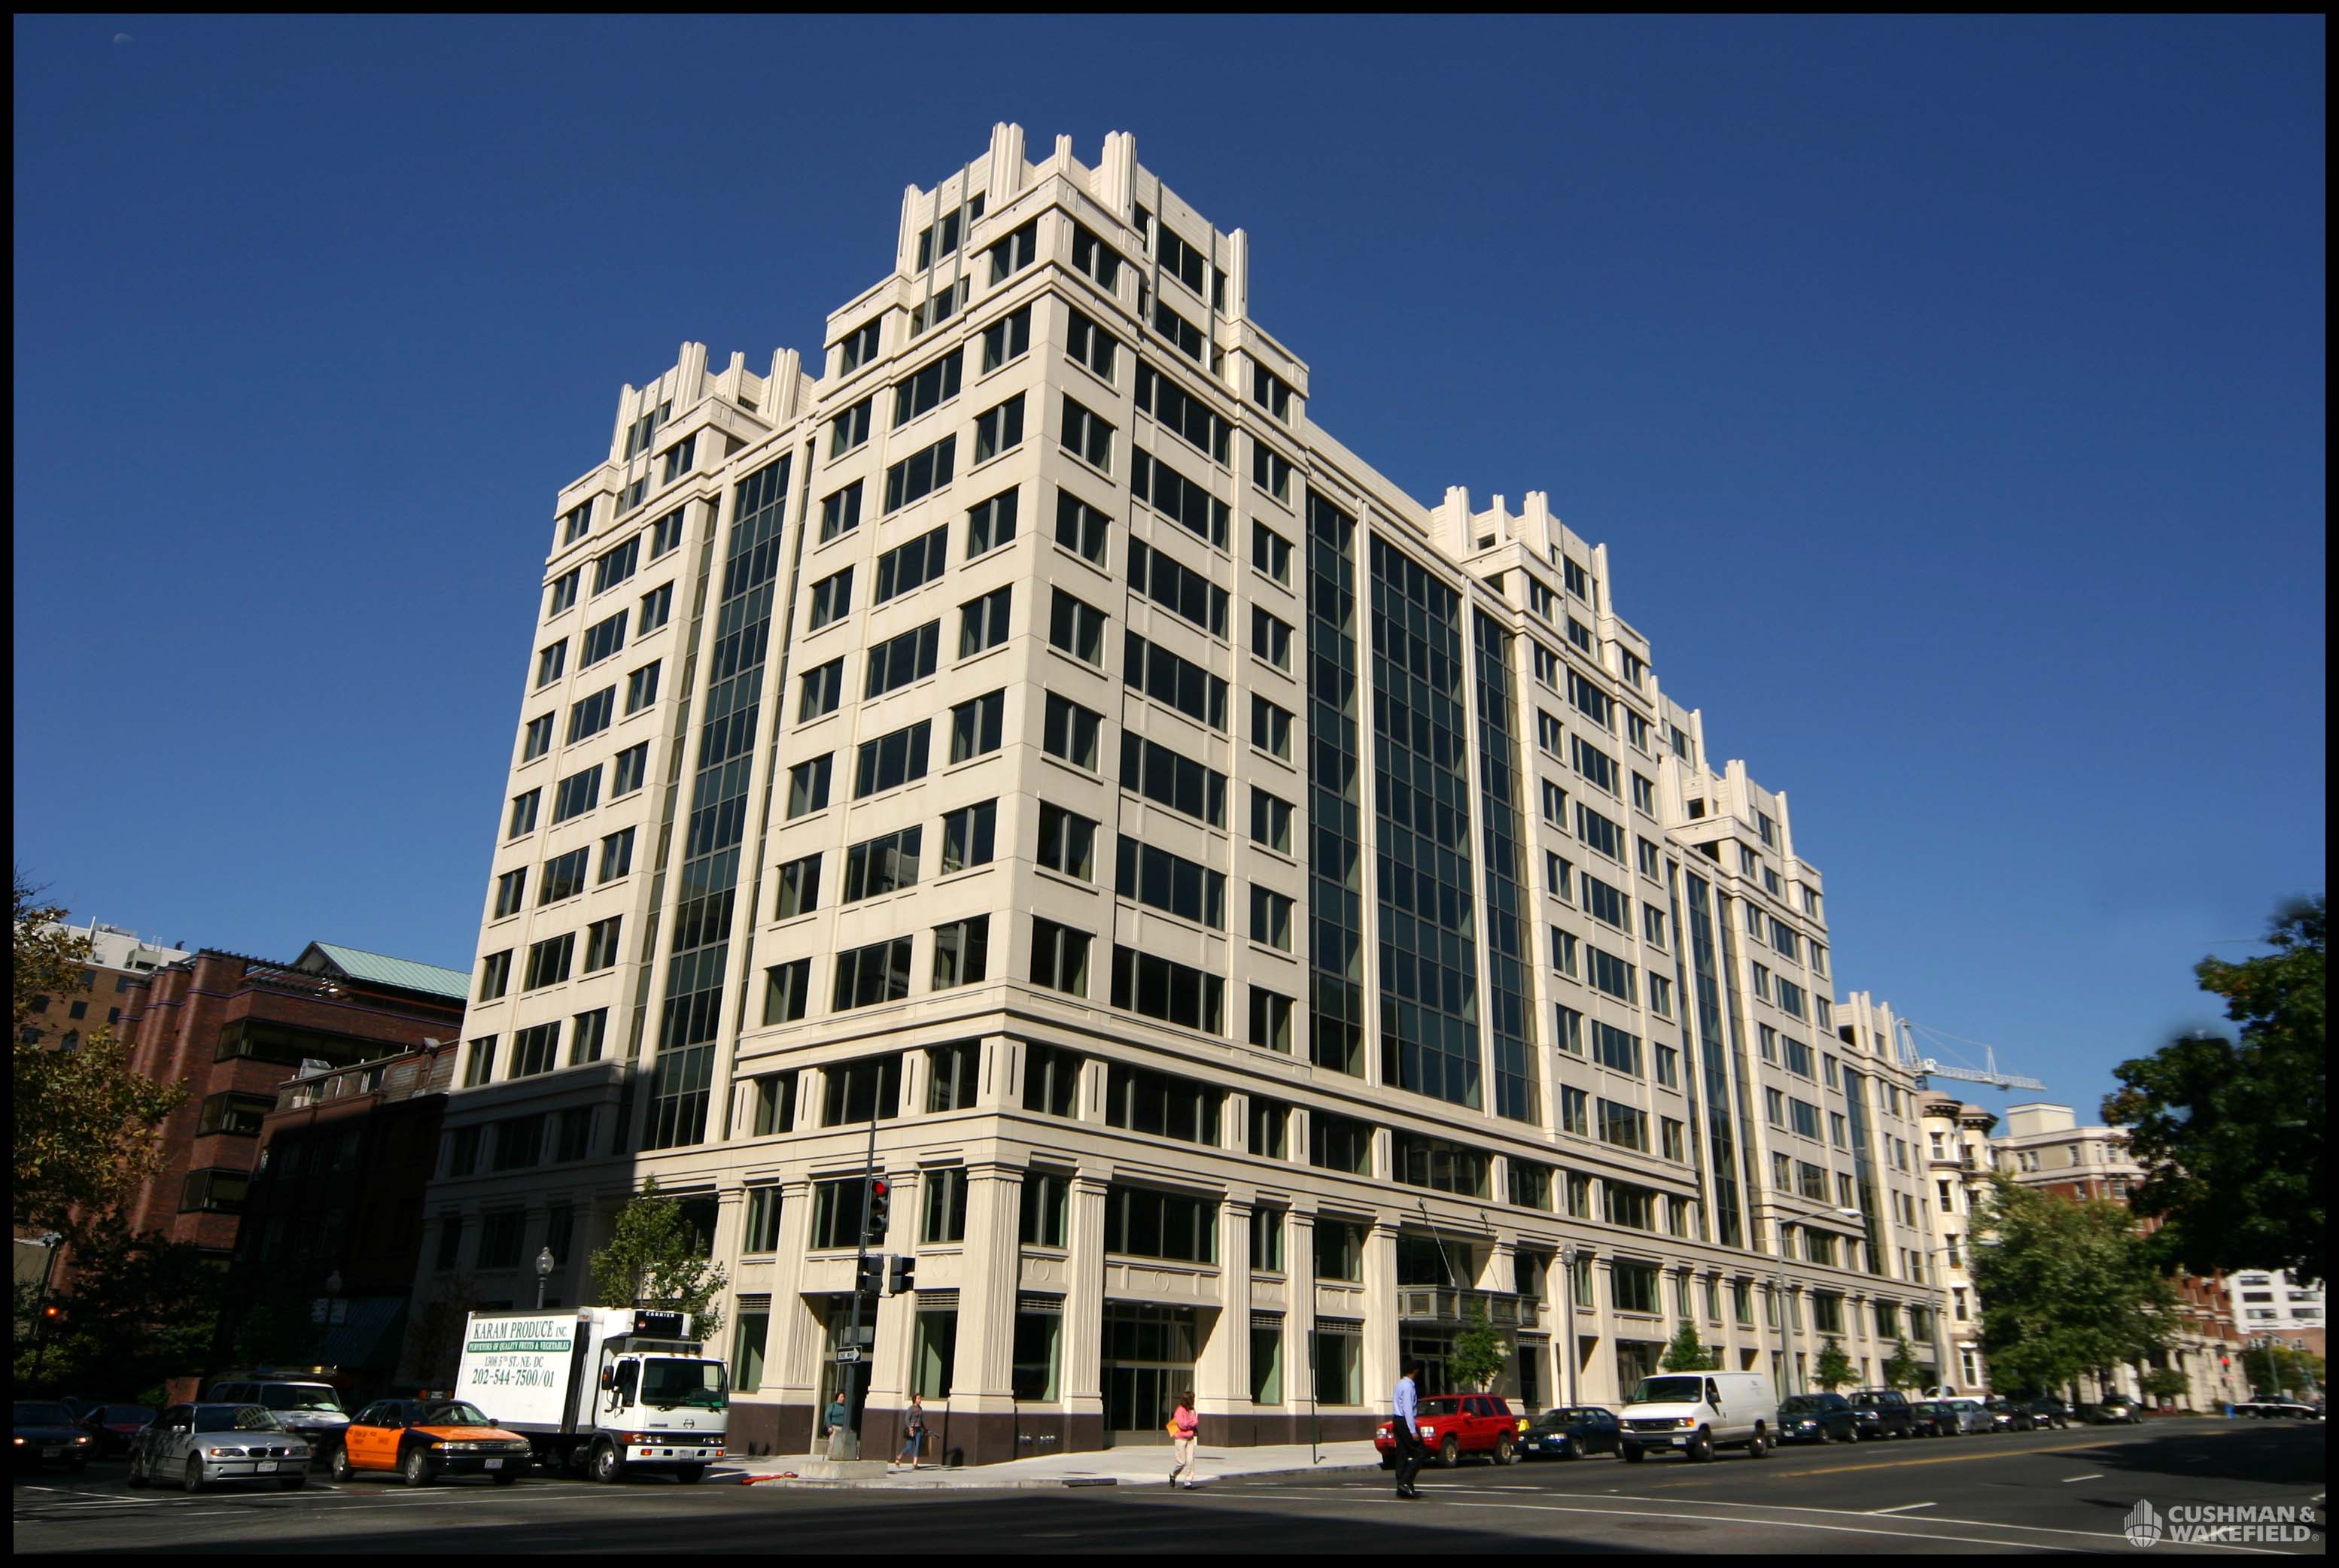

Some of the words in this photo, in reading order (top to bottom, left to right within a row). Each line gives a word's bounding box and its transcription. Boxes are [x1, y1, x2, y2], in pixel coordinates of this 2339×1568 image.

[474, 1323, 508, 1339] KARAM
[510, 1320, 554, 1338] PRODUCE
[498, 1342, 518, 1351] QUALITY
[518, 1342, 535, 1351] FRUITS
[540, 1341, 570, 1350] VEGETABLES
[533, 1356, 544, 1368] DC
[472, 1369, 554, 1387] 202-544-7500/01
